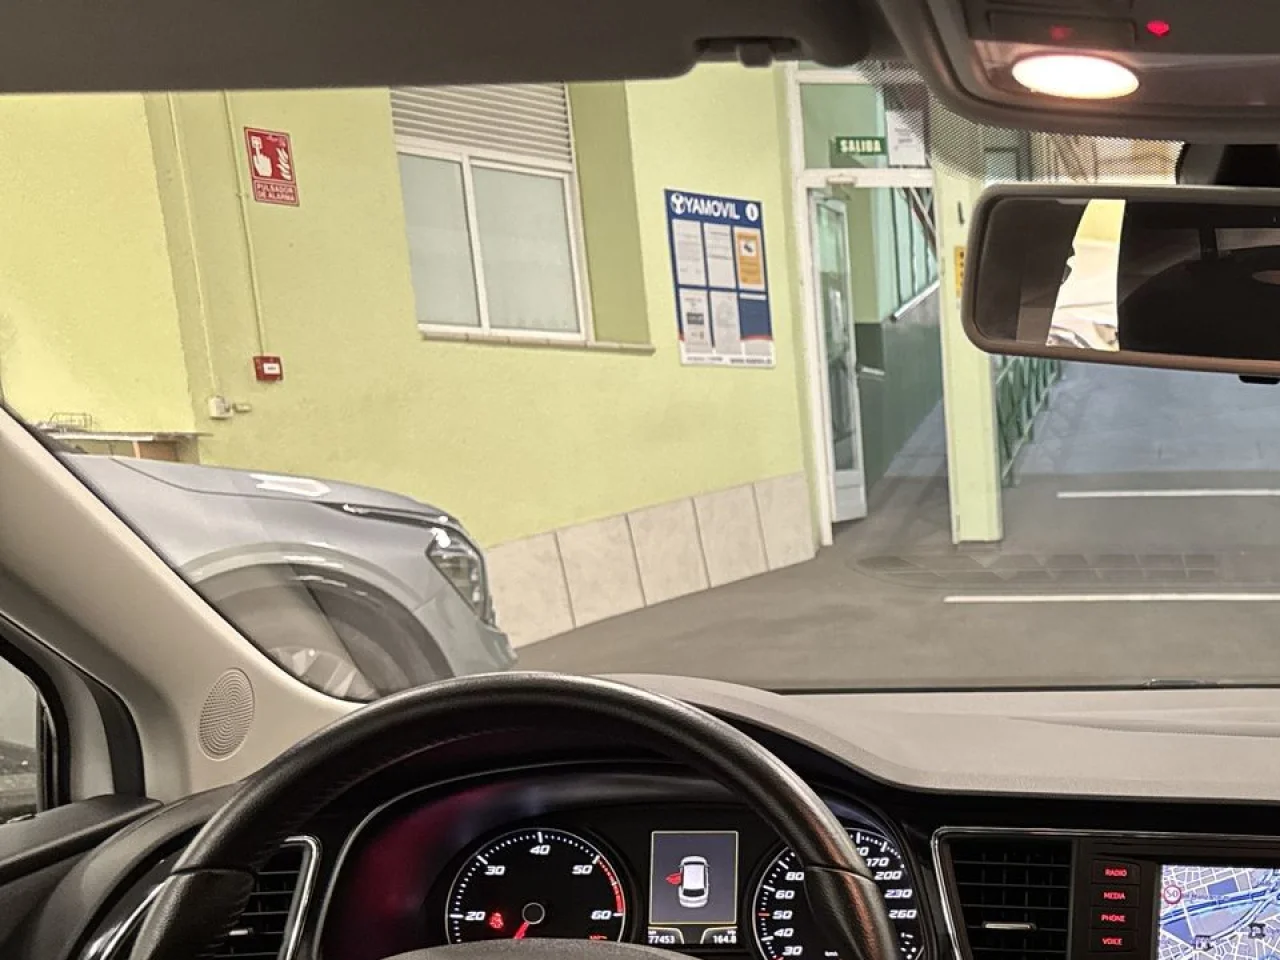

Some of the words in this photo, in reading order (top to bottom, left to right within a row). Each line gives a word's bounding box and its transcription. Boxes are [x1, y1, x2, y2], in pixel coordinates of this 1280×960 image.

[840, 139, 882, 153] SALIDA
[684, 196, 740, 220] YAMOVIL
[529, 844, 551, 855] 40
[866, 857, 889, 867] 170
[484, 865, 506, 876] 30
[572, 865, 593, 876] 50
[874, 871, 902, 880] 200
[1104, 868, 1128, 877] RADIO
[784, 871, 805, 881] 80
[775, 889, 795, 899] 60
[884, 889, 913, 898] 230
[1103, 891, 1126, 900] MEDIA
[464, 911, 486, 921] 20
[591, 910, 612, 920] 60
[772, 910, 793, 920] 50
[888, 909, 917, 919] 260
[1101, 914, 1126, 922] PHONE
[773, 928, 794, 937] 40
[1102, 938, 1123, 946] VOICE
[782, 946, 803, 956] 30
